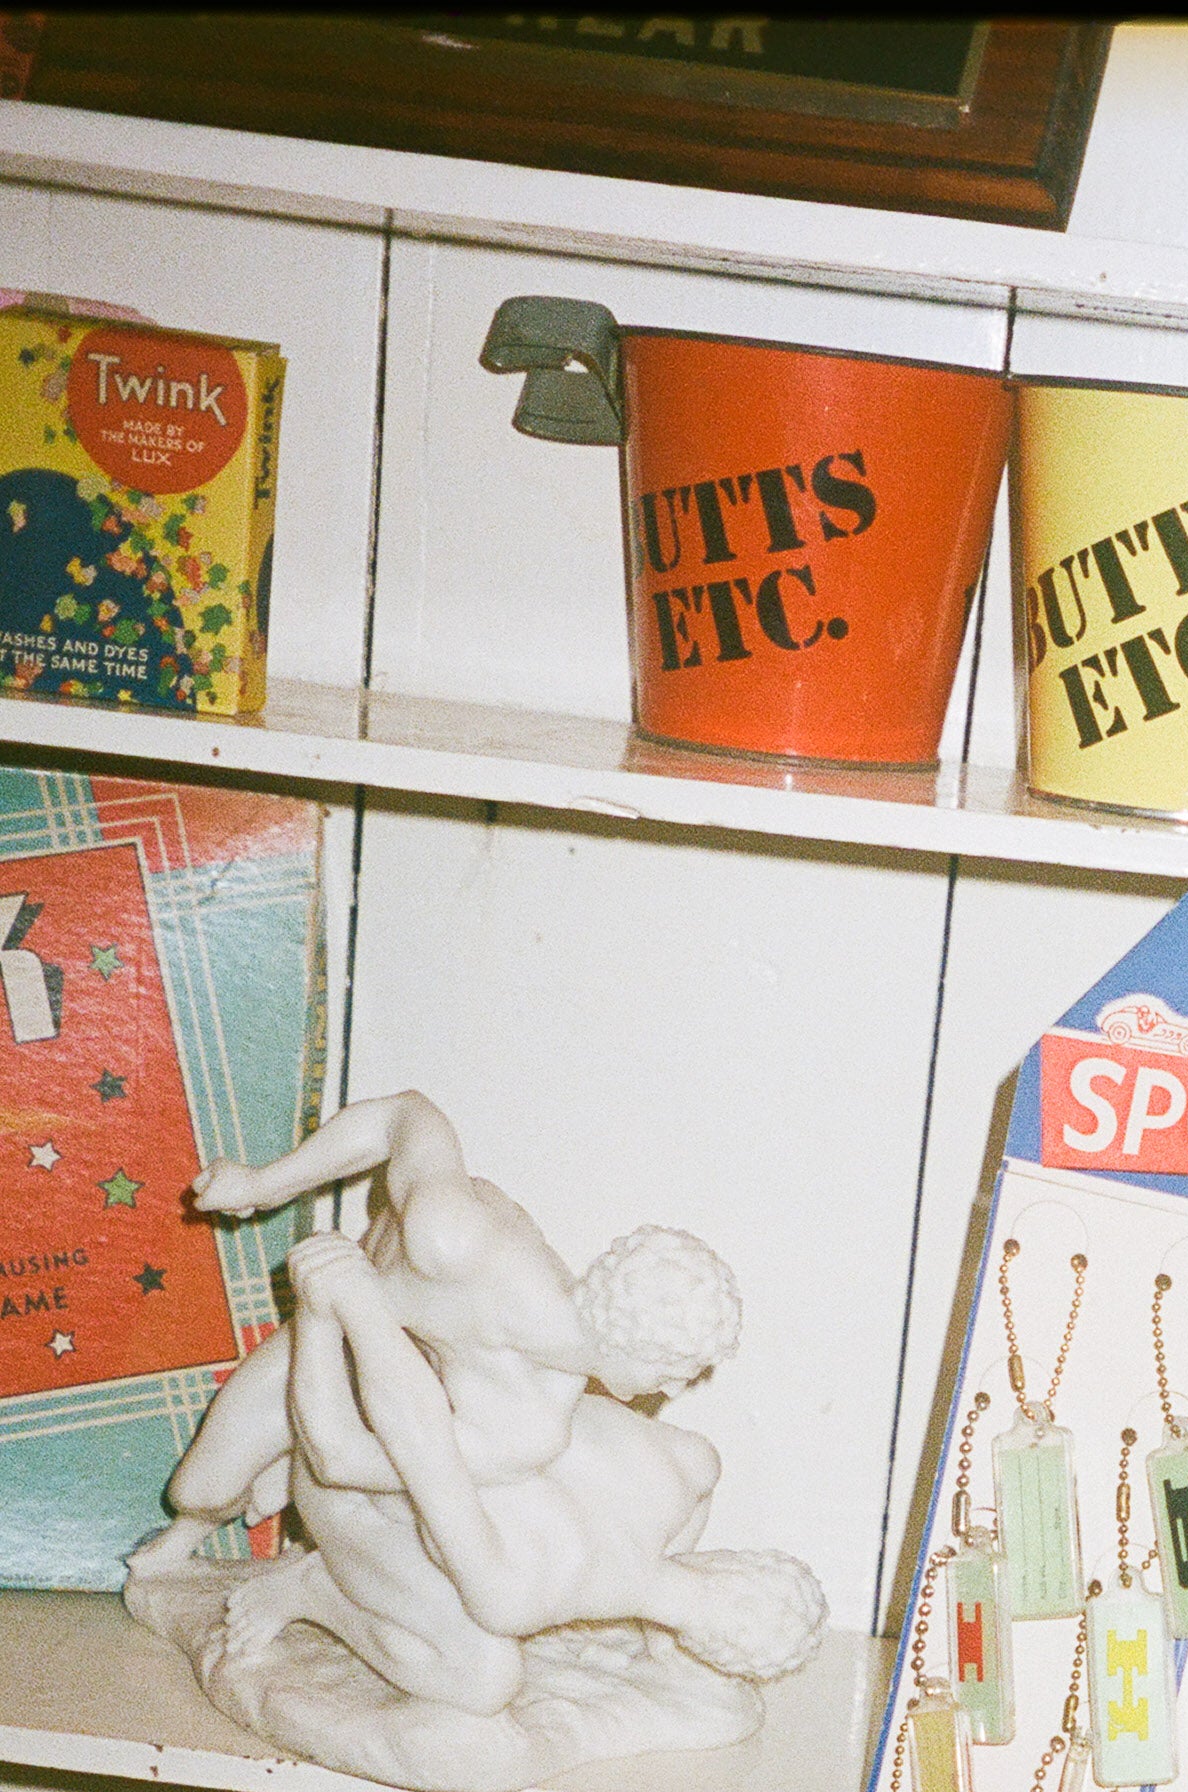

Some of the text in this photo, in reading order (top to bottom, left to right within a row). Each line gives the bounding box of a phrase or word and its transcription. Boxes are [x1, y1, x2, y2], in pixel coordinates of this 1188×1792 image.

[87, 352, 228, 427] Twink
[101, 430, 205, 453] THE MAKERS OF
[123, 420, 184, 436] MADE BY
[131, 448, 171, 466] LUX
[640, 448, 877, 574] UTTS
[652, 564, 850, 672] ETC.
[0, 631, 149, 662] ASHES AND DYES
[12, 650, 46, 668] THE
[51, 655, 99, 674] SAME
[103, 662, 148, 680] TIME
[0, 1285, 69, 1320] AME
